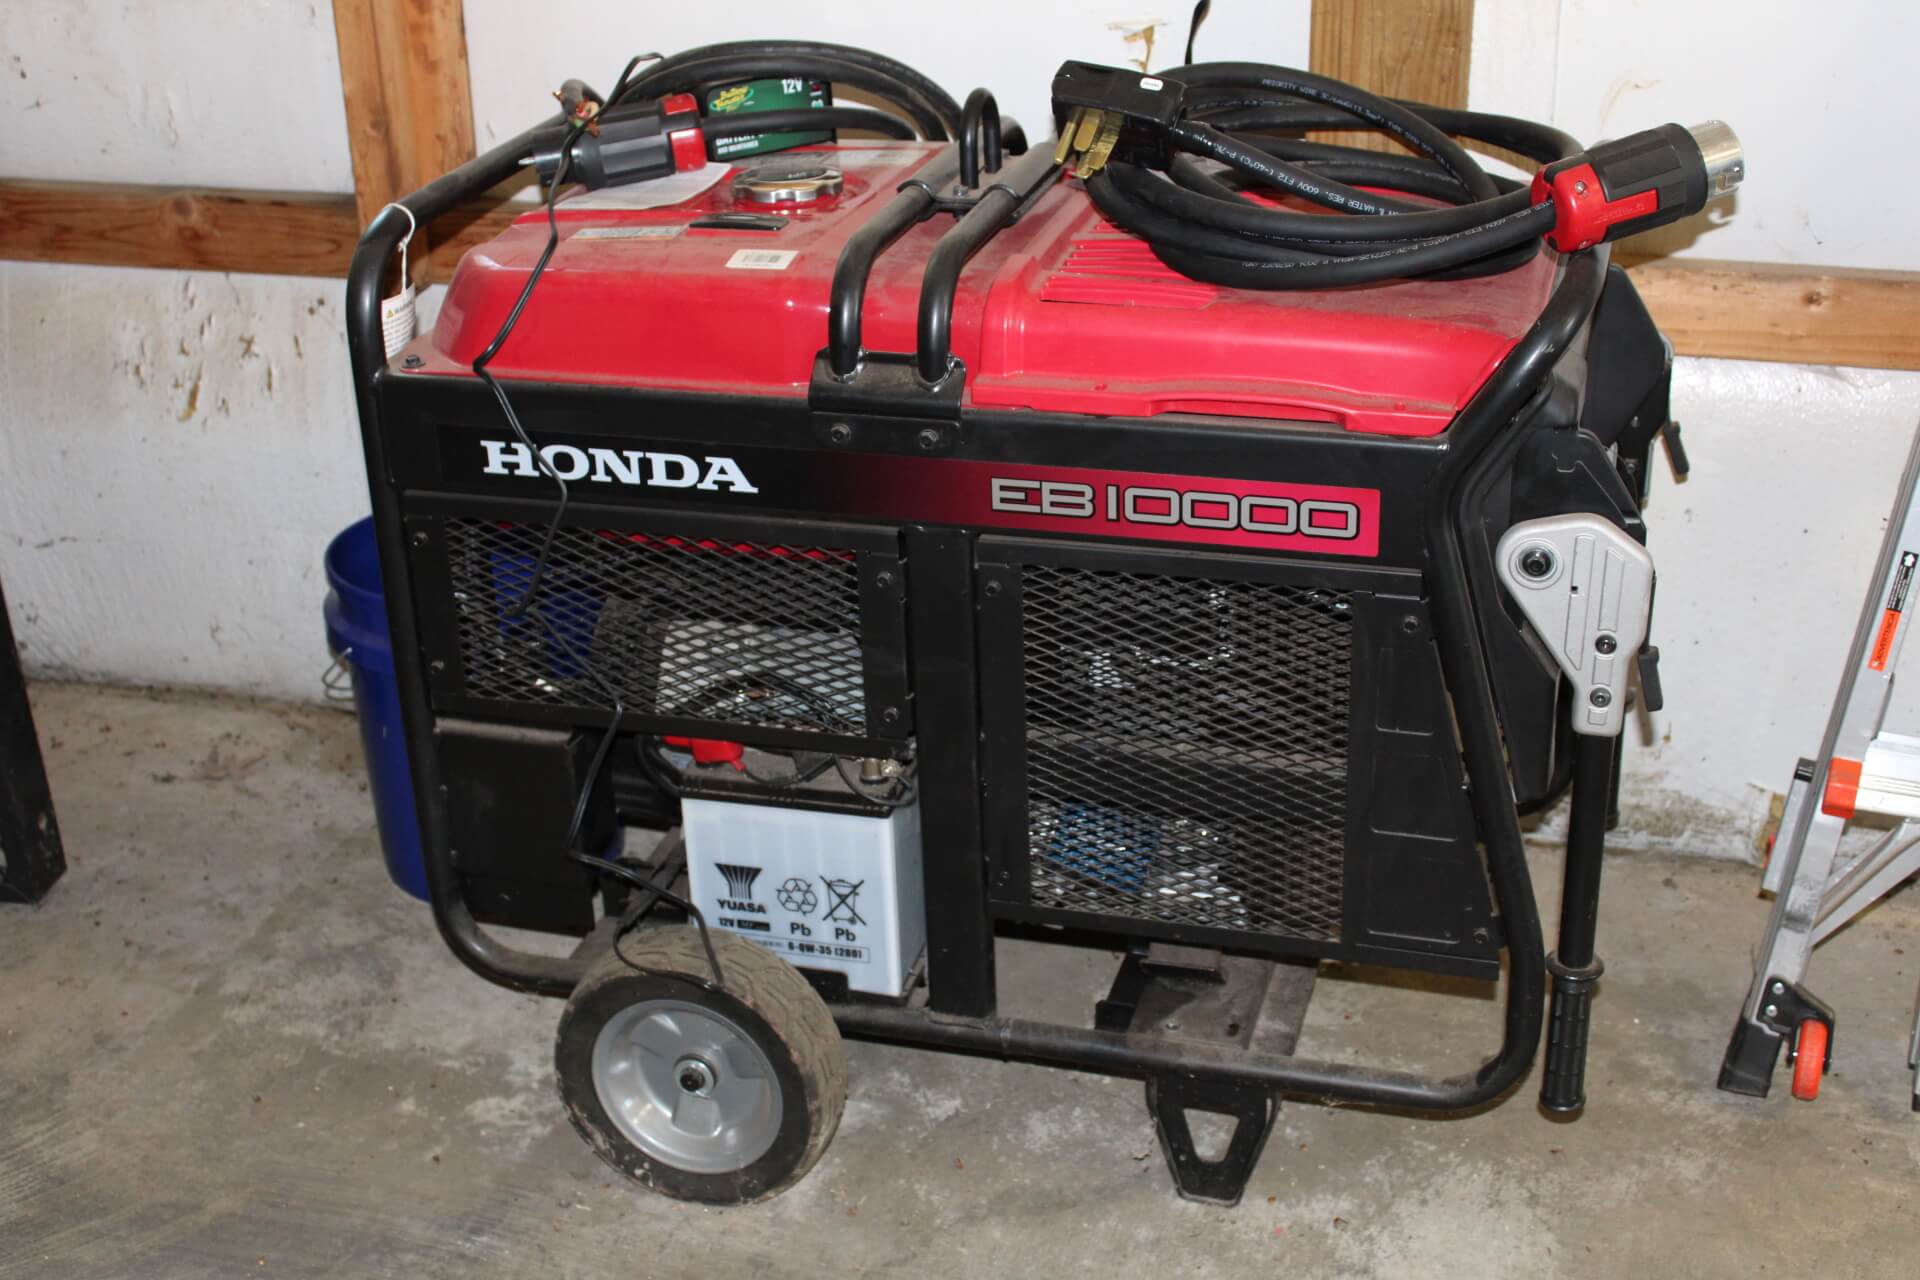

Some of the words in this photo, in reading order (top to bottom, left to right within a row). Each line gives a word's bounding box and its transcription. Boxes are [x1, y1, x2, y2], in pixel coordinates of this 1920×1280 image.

[782, 78, 802, 94] 12V
[1296, 181, 1320, 196] 600V
[1325, 191, 1345, 205] RES.
[1347, 200, 1375, 214] WATER
[479, 439, 759, 494] HONDA
[717, 899, 767, 915] YUASA
[718, 917, 735, 928] 12V
[790, 922, 812, 937] Pb
[834, 927, 857, 942] Pb
